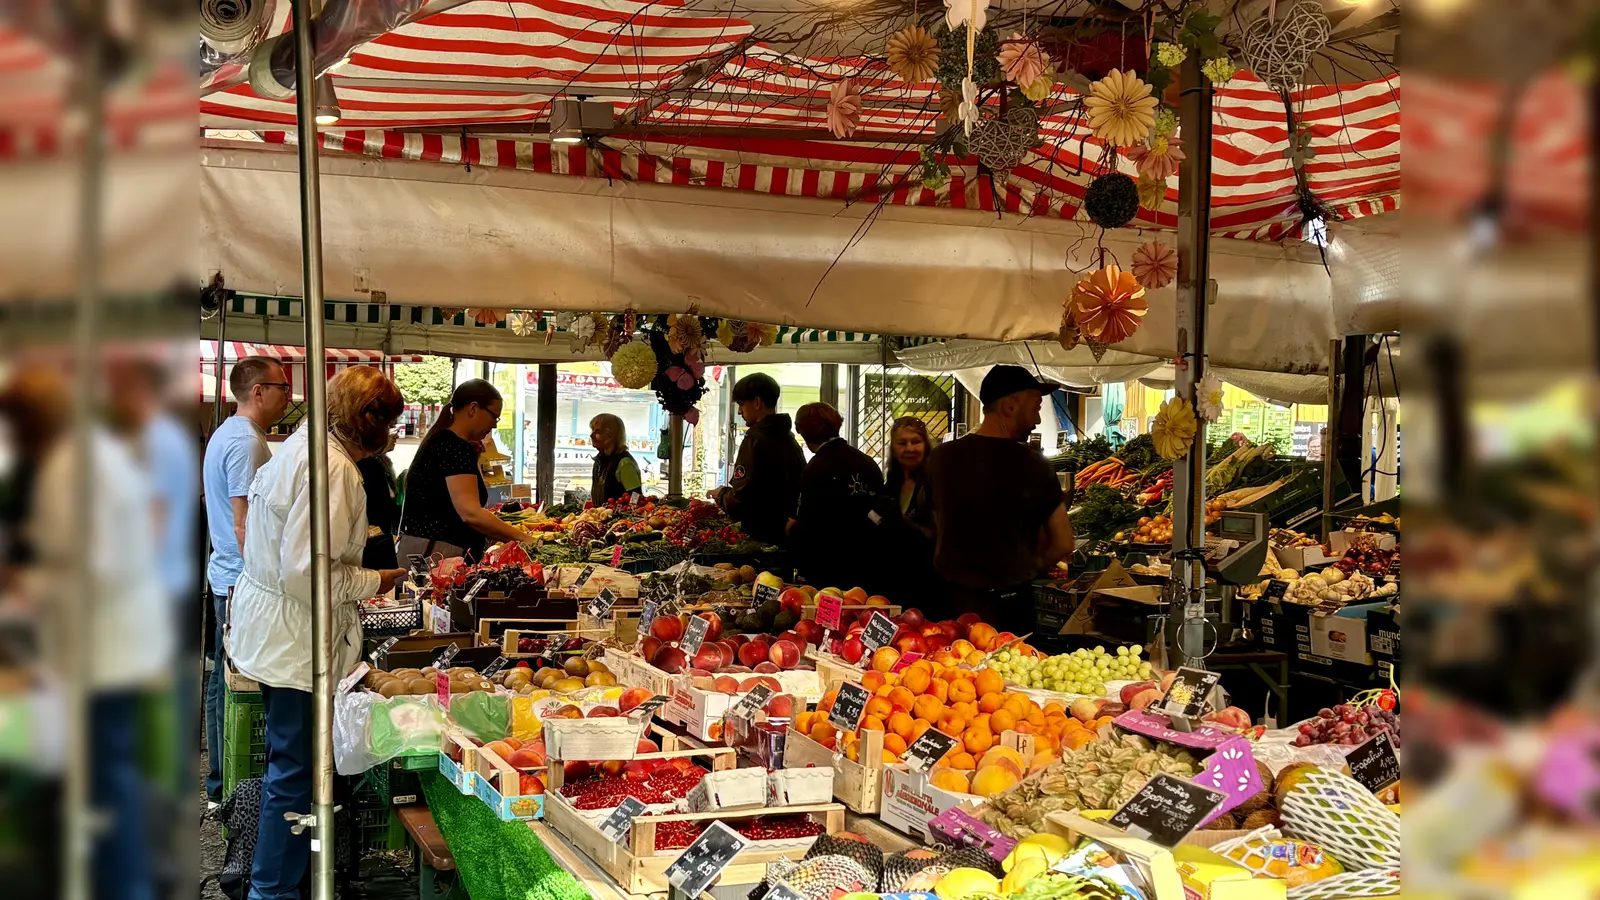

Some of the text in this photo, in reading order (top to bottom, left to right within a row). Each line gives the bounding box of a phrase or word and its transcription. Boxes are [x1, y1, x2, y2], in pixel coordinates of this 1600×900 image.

[576, 375, 616, 386] BABA
[1350, 747, 1384, 775] Grapefruit
[697, 860, 717, 877] 8.95
